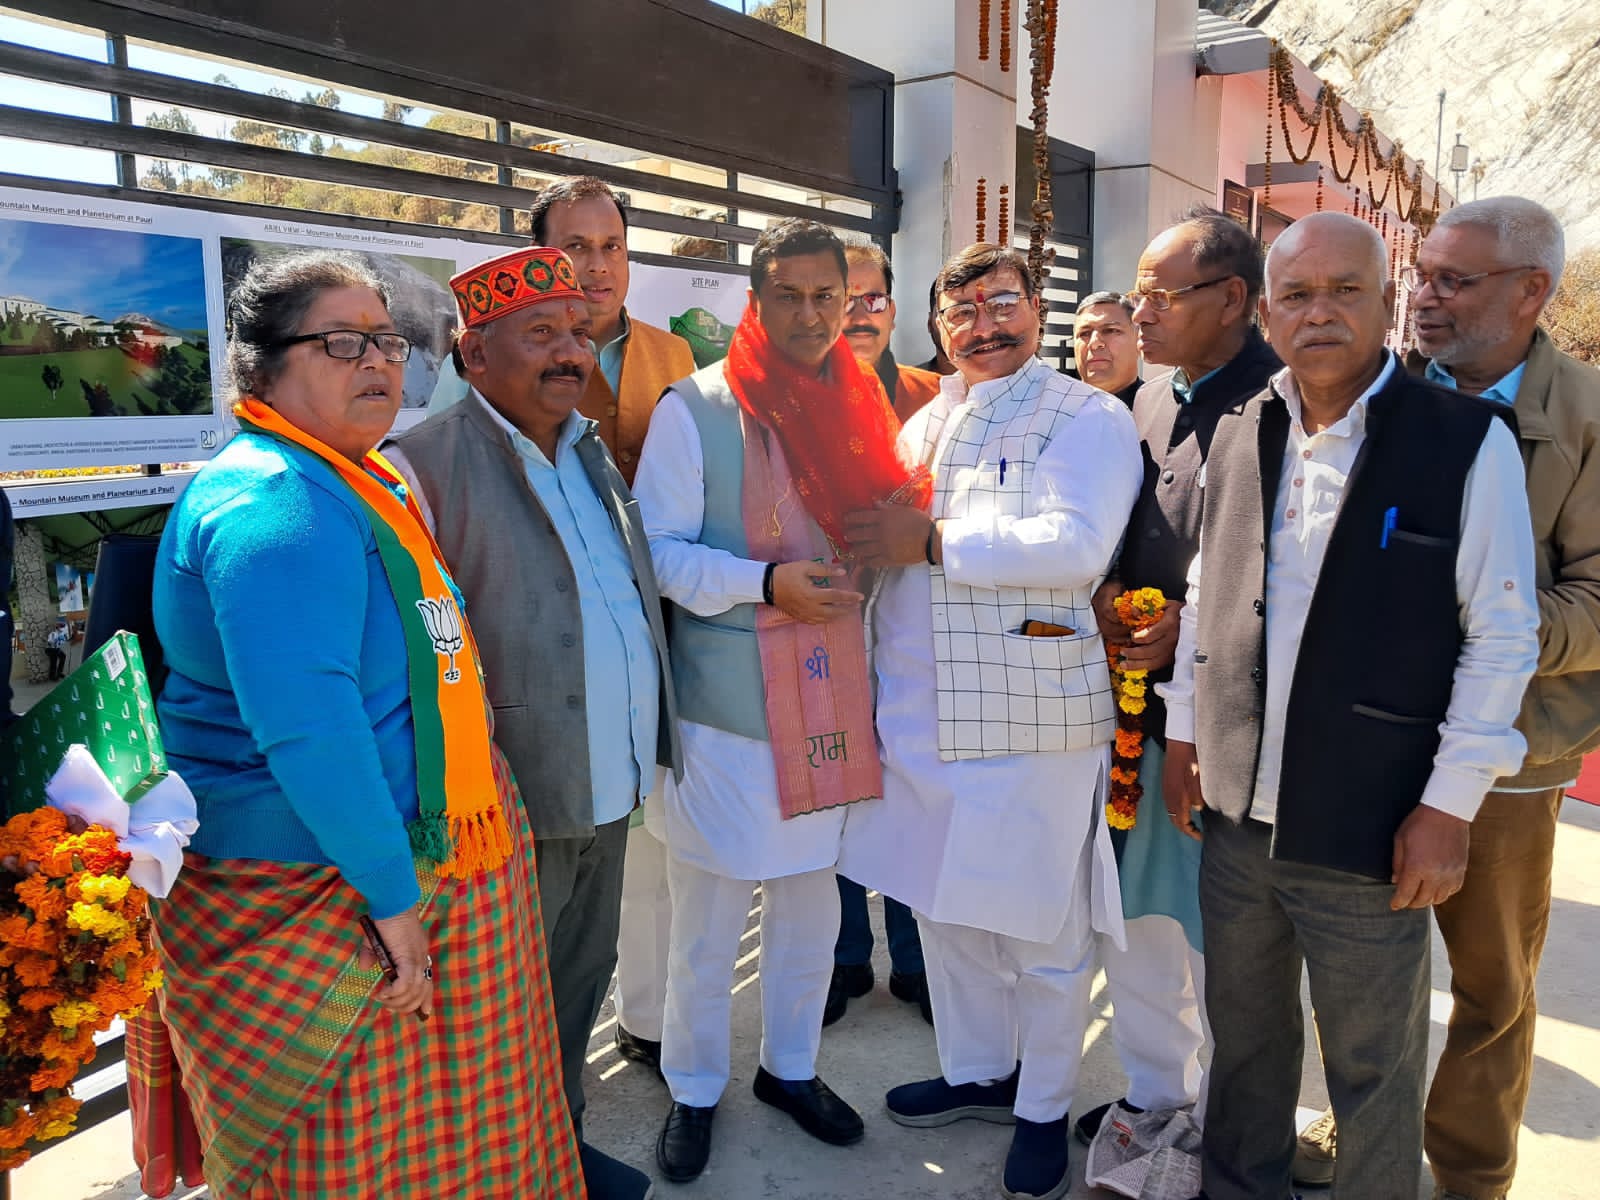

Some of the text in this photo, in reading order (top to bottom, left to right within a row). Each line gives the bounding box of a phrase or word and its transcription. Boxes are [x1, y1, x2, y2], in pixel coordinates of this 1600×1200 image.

[0, 201, 30, 209] ountain
[32, 203, 65, 214] Museum
[82, 209, 126, 221] Planetarium
[692, 278, 720, 288] SITE PLAN
[19, 496, 57, 506] Mountain
[58, 493, 90, 502] Museum
[92, 491, 105, 499] and
[107, 488, 148, 498] Planetarium
[158, 485, 175, 493] Pauri
[804, 646, 830, 680] श्री
[805, 730, 848, 768] राम
